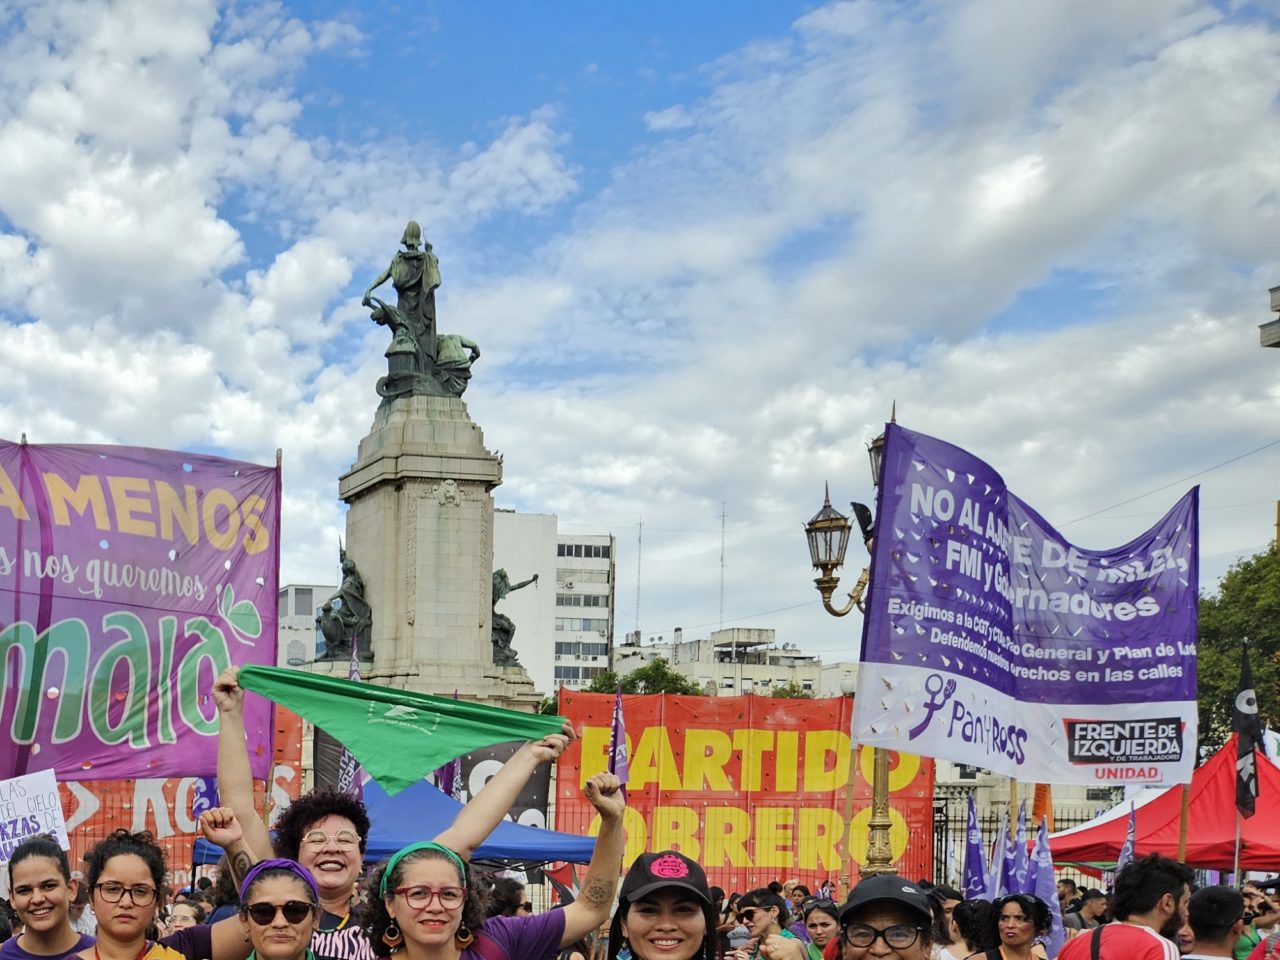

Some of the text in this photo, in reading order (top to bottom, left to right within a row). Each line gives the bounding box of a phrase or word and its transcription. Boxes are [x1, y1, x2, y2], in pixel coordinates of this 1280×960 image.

[43, 471, 269, 556] MENOS
[910, 483, 955, 521] NO
[958, 498, 983, 535] AL
[1041, 539, 1089, 577] DE
[23, 548, 79, 584] nos
[78, 558, 208, 601] queremos
[946, 539, 983, 581] FMI
[983, 562, 994, 593] y
[887, 598, 955, 625] Exigimos
[956, 612, 963, 626] a
[1021, 642, 1093, 661] General
[1096, 649, 1111, 665] y
[1112, 645, 1153, 661] Plan
[1155, 642, 1175, 658] de
[930, 626, 988, 660] Defendemos
[1074, 669, 1100, 682] en
[1104, 667, 1135, 683] las
[1137, 663, 1184, 681] calles
[1073, 721, 1177, 740] FRENTE DE
[1073, 738, 1181, 758] IZQUIERDA
[578, 724, 922, 794] PARTIDO
[1094, 766, 1159, 781] UNIDAD
[1116, 755, 1127, 763] DE
[0, 779, 27, 802] LAS
[0, 801, 22, 821] DEL
[587, 804, 909, 872] OBRERO
